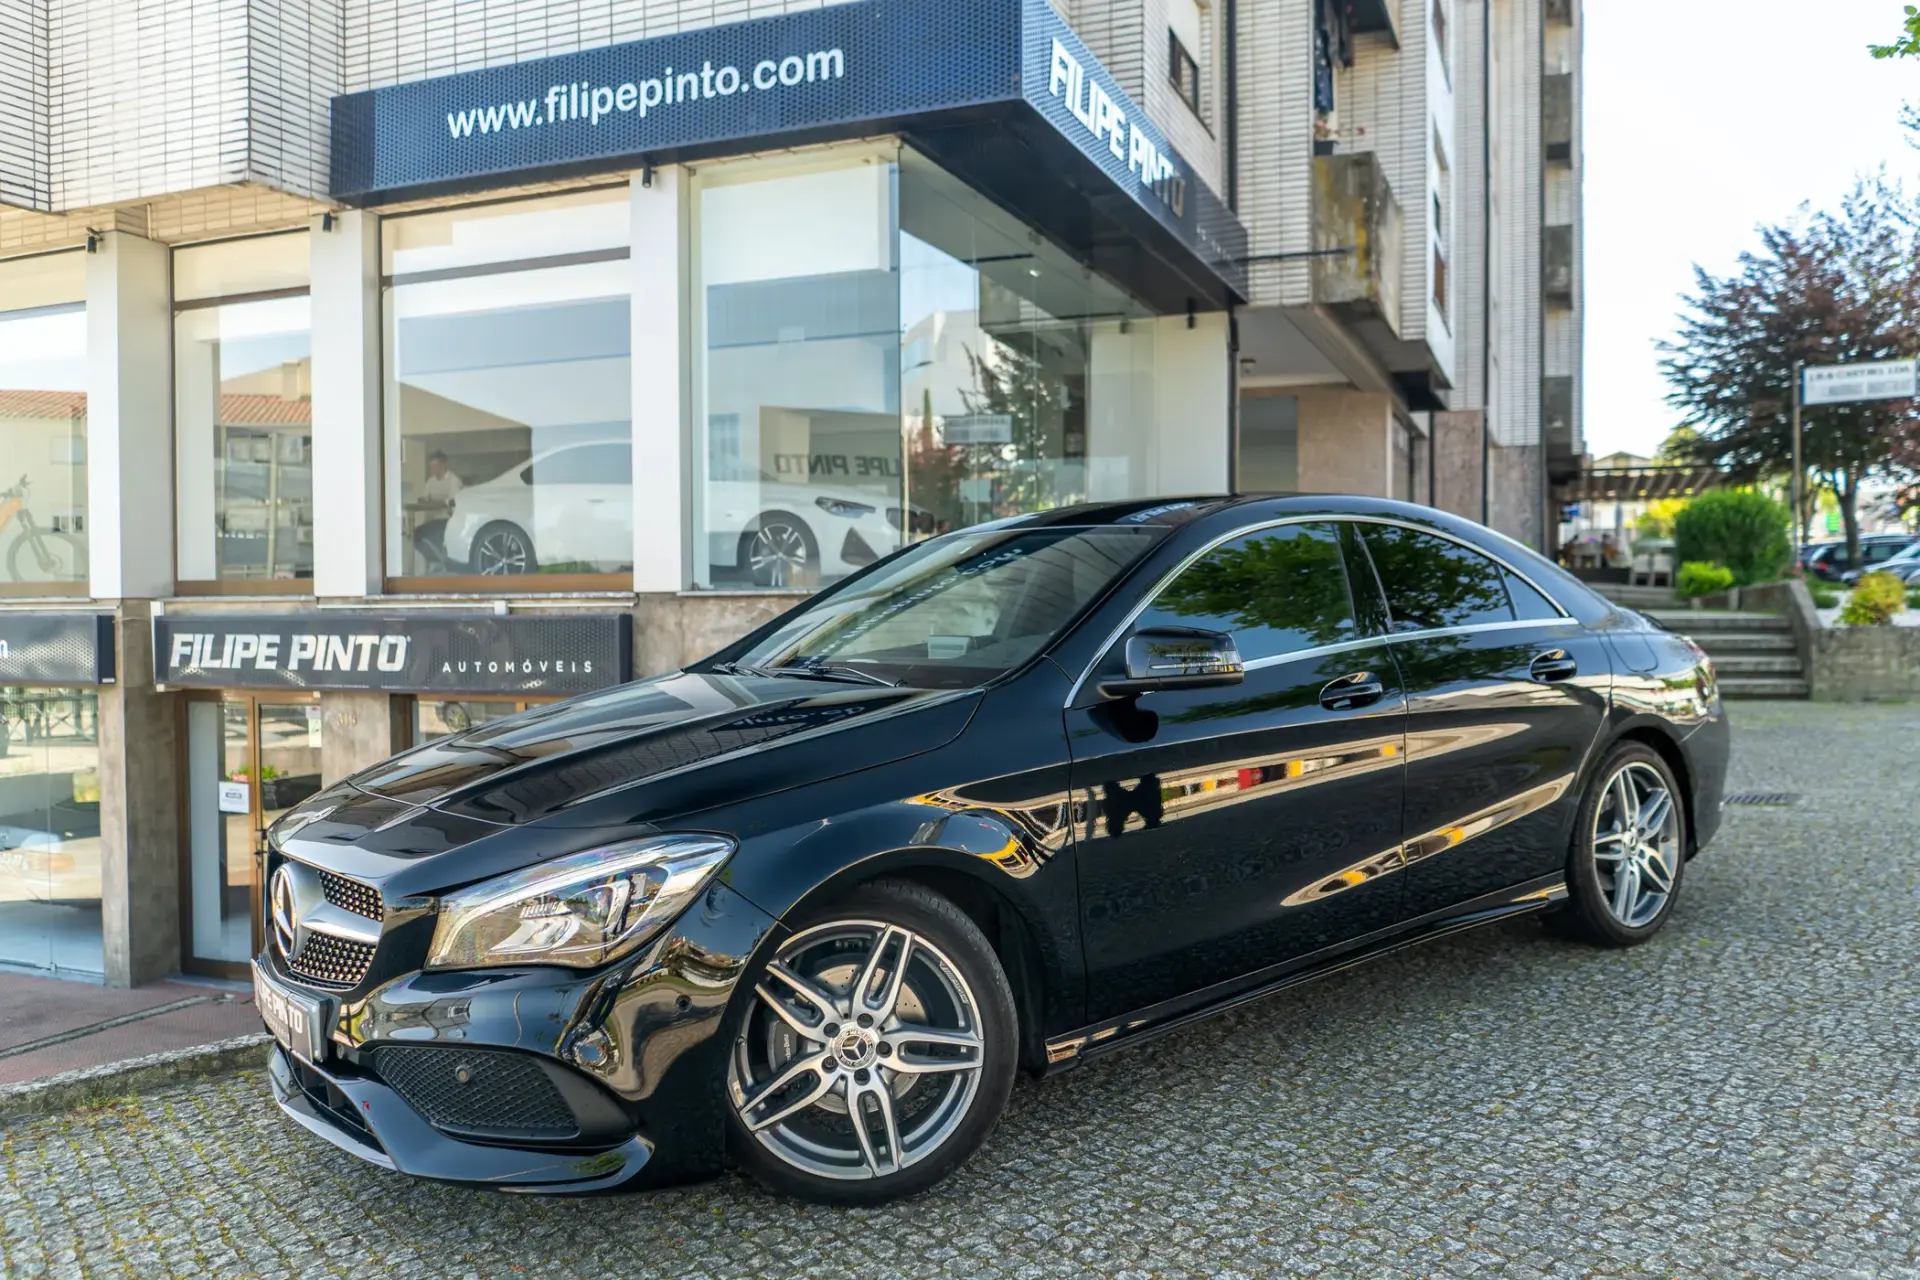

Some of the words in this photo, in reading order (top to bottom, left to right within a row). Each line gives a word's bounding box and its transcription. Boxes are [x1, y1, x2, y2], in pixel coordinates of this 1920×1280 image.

[447, 47, 844, 139] www.filipepinto.com
[1050, 37, 1127, 161] FILIPE
[1128, 122, 1186, 219] PINTO
[169, 632, 281, 670] FILIPE
[287, 634, 408, 672] PINTO
[442, 658, 593, 673] AUTOMÓVEIS
